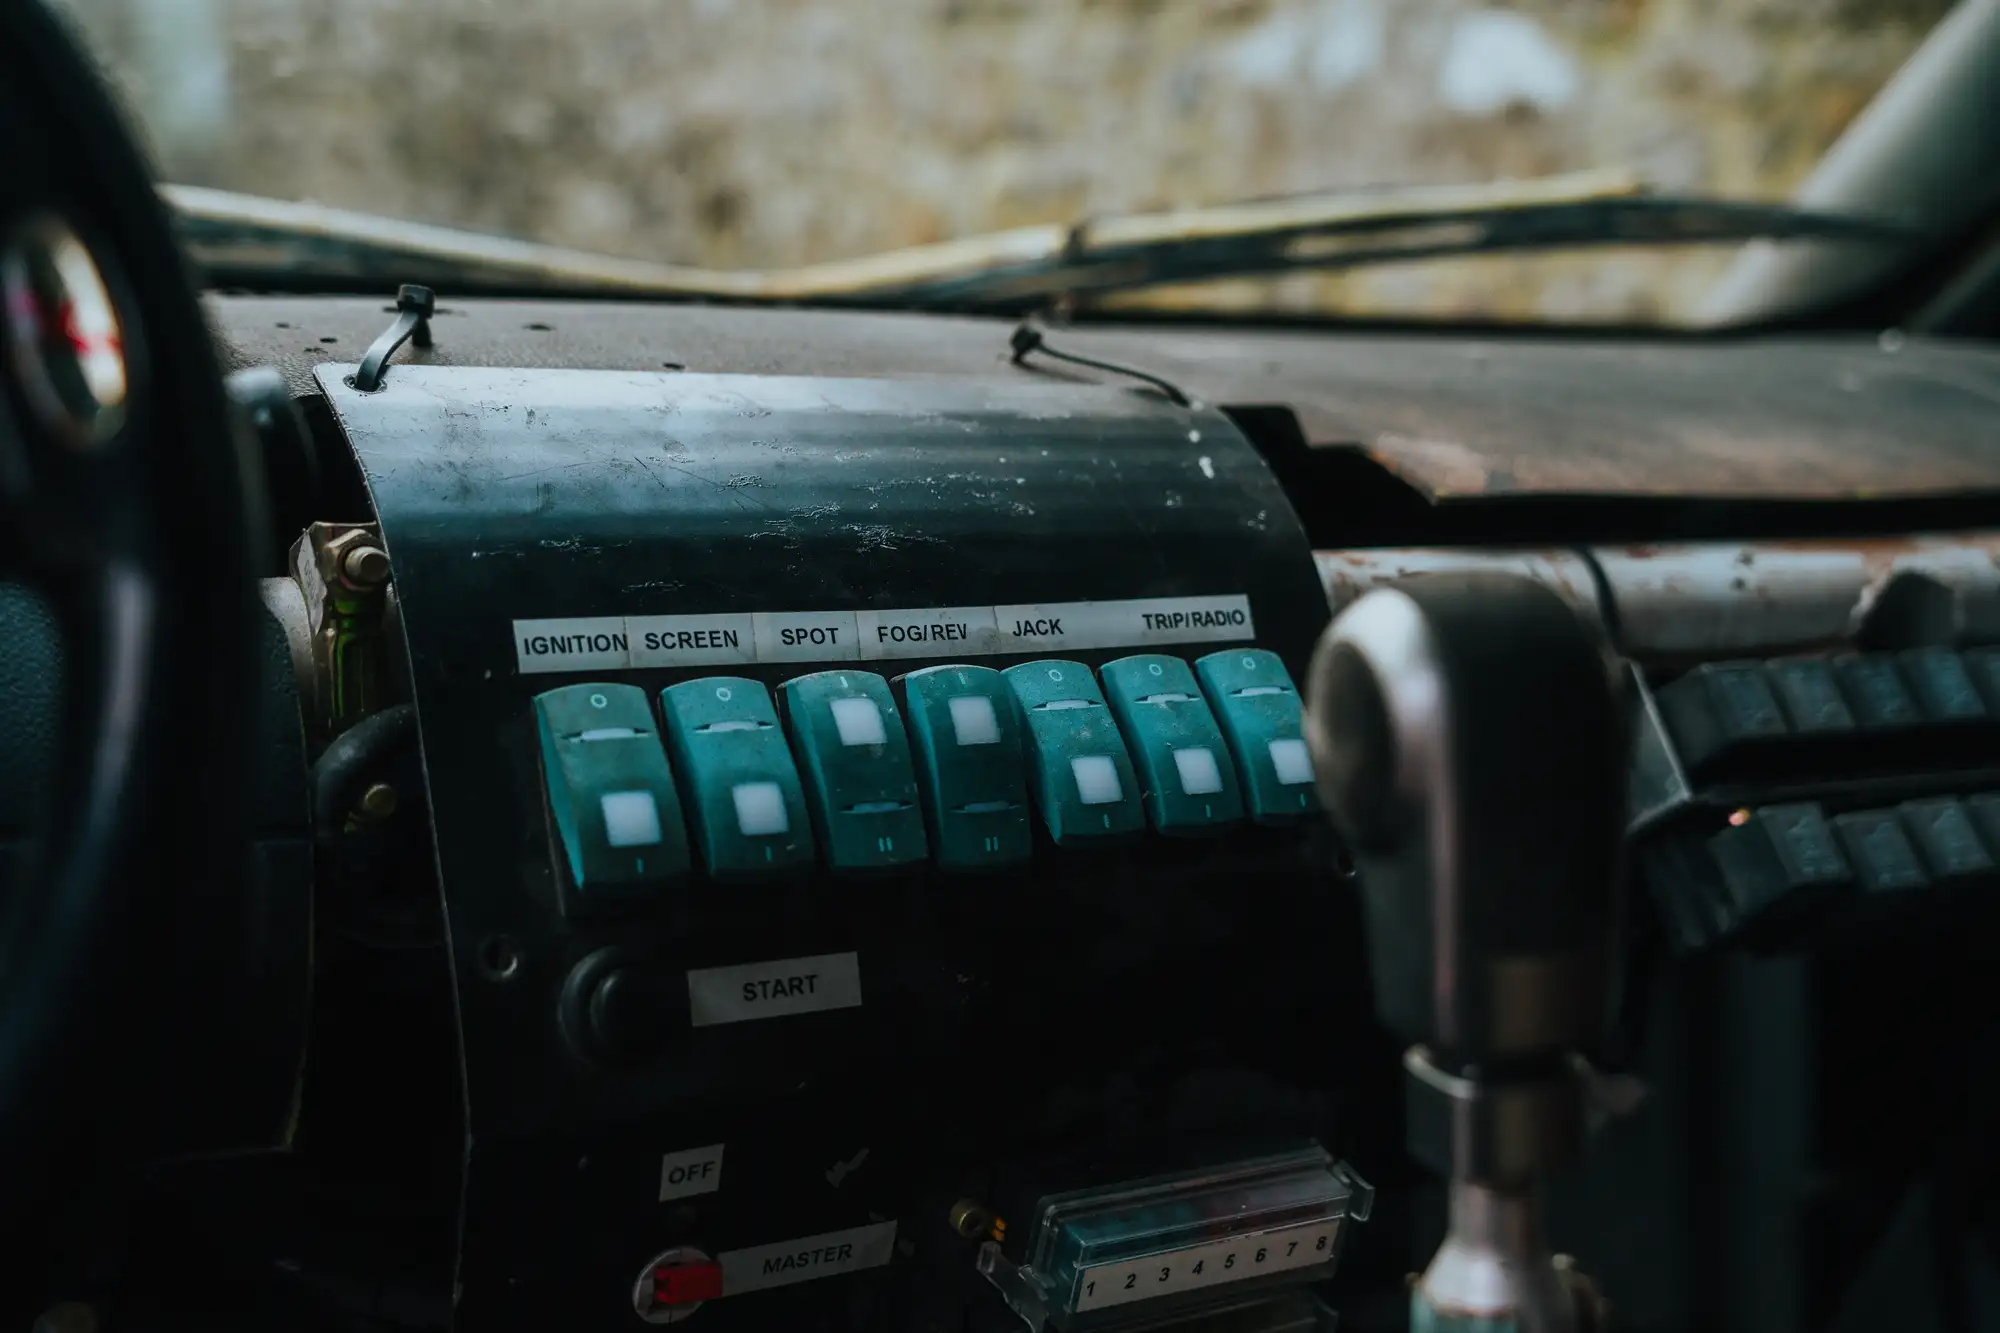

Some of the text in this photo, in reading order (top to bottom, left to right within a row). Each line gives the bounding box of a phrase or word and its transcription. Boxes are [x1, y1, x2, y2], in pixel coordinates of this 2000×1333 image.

[523, 609, 1246, 656] IGNITION SCREEN SPOT FOG/REV JACK TRIP/RADIO
[742, 974, 818, 1002] START
[667, 1160, 717, 1185] OFF
[762, 1242, 854, 1275] MASTER
[1085, 1235, 1328, 1297] 1 2 3 4 5 6 7 8
